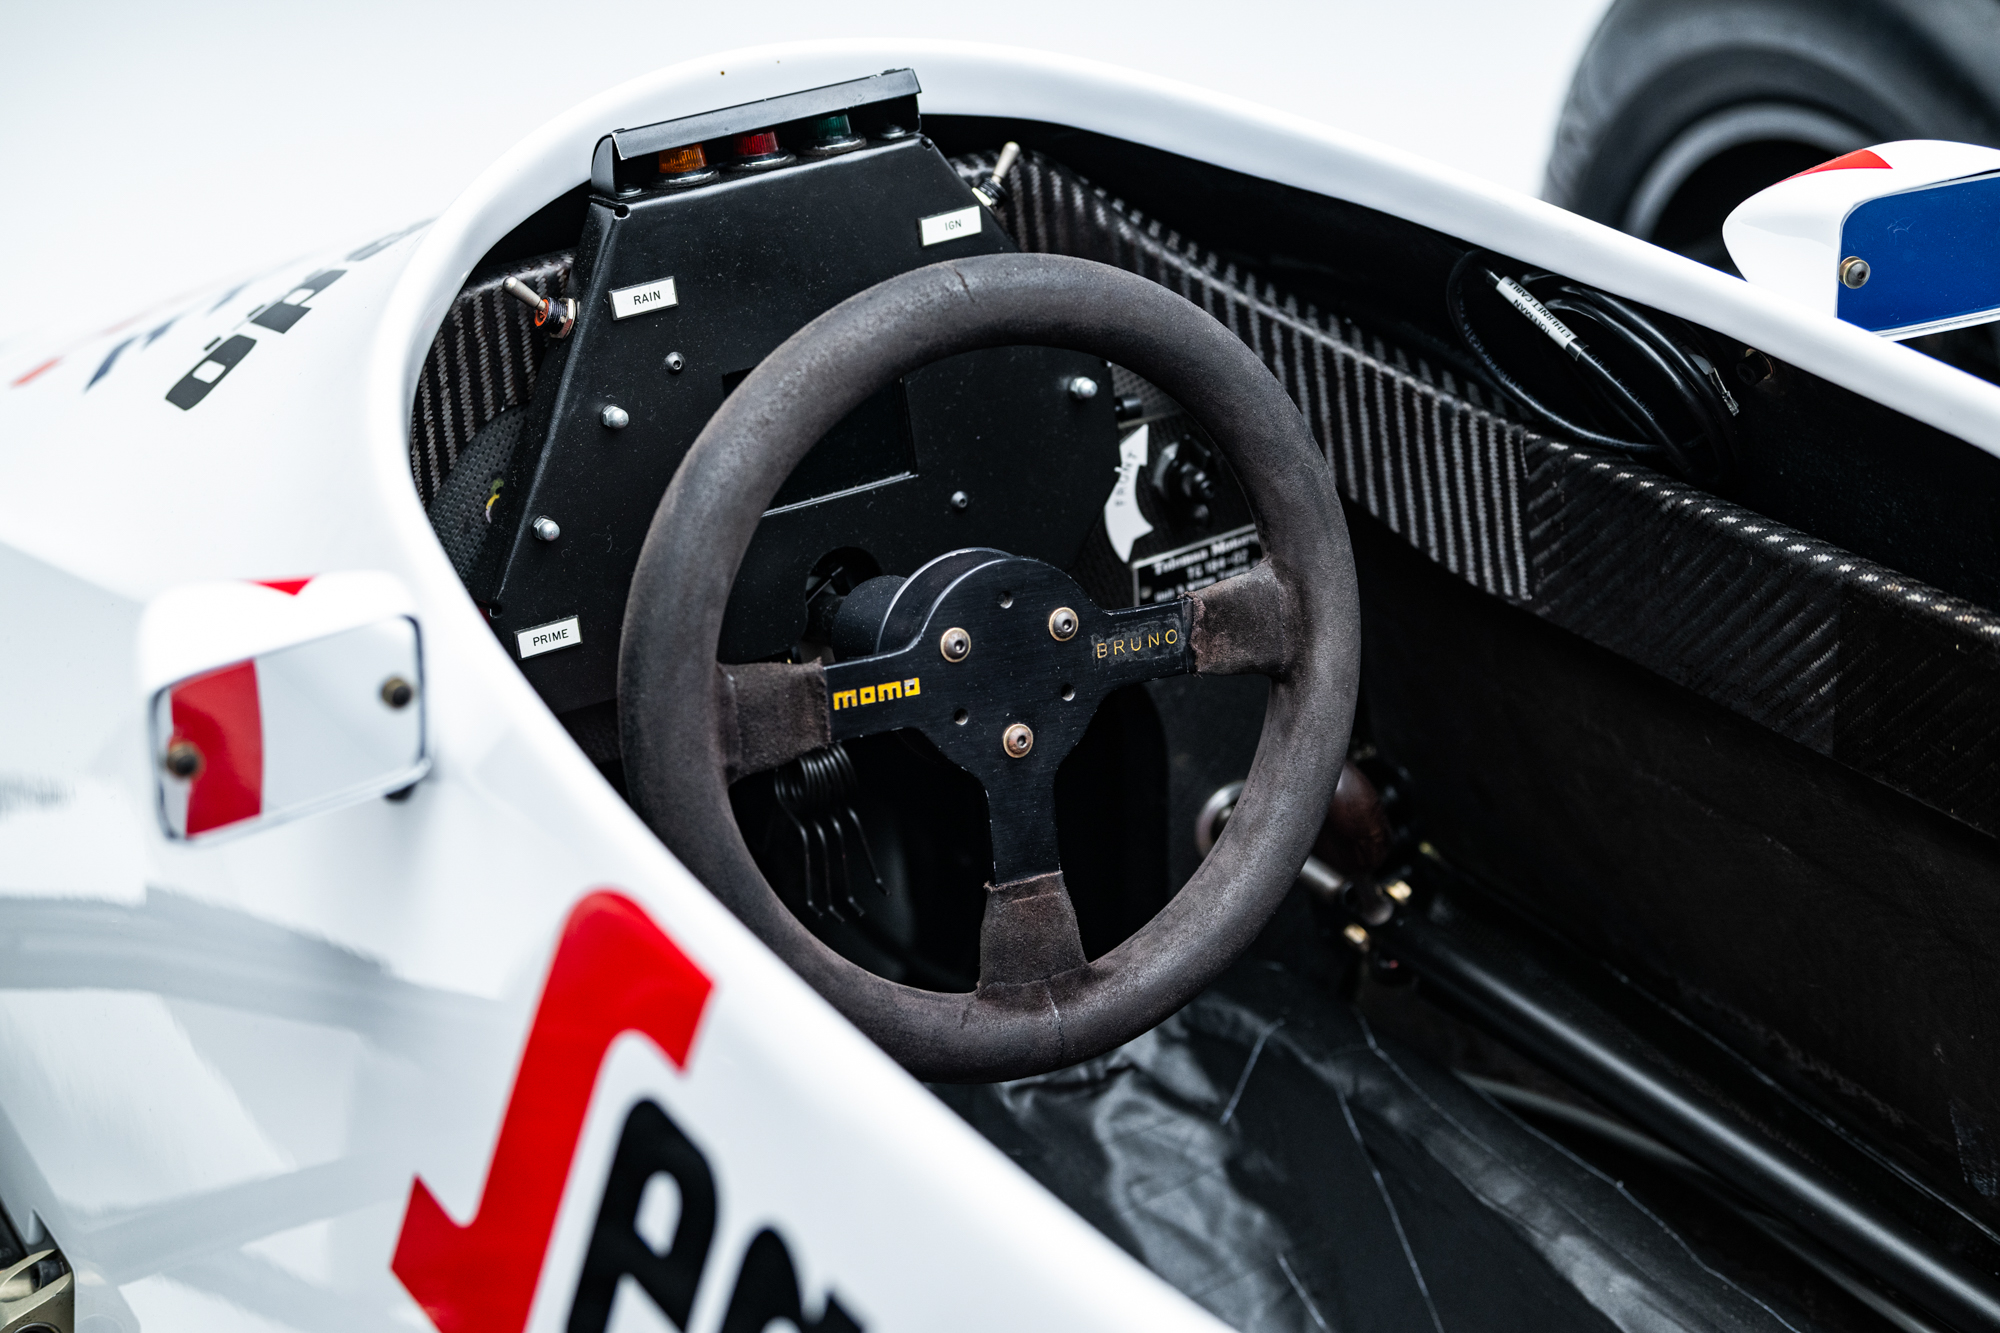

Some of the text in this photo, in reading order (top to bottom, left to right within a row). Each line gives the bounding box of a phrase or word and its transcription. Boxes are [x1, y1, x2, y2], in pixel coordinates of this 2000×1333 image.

[943, 217, 964, 232] IGN
[632, 289, 663, 306] RAIN
[1506, 280, 1537, 305] CABLE
[1536, 299, 1571, 339] ETHERNET
[532, 627, 571, 647] PRIME
[1096, 628, 1180, 660] BRUNO
[832, 676, 921, 711] momo
